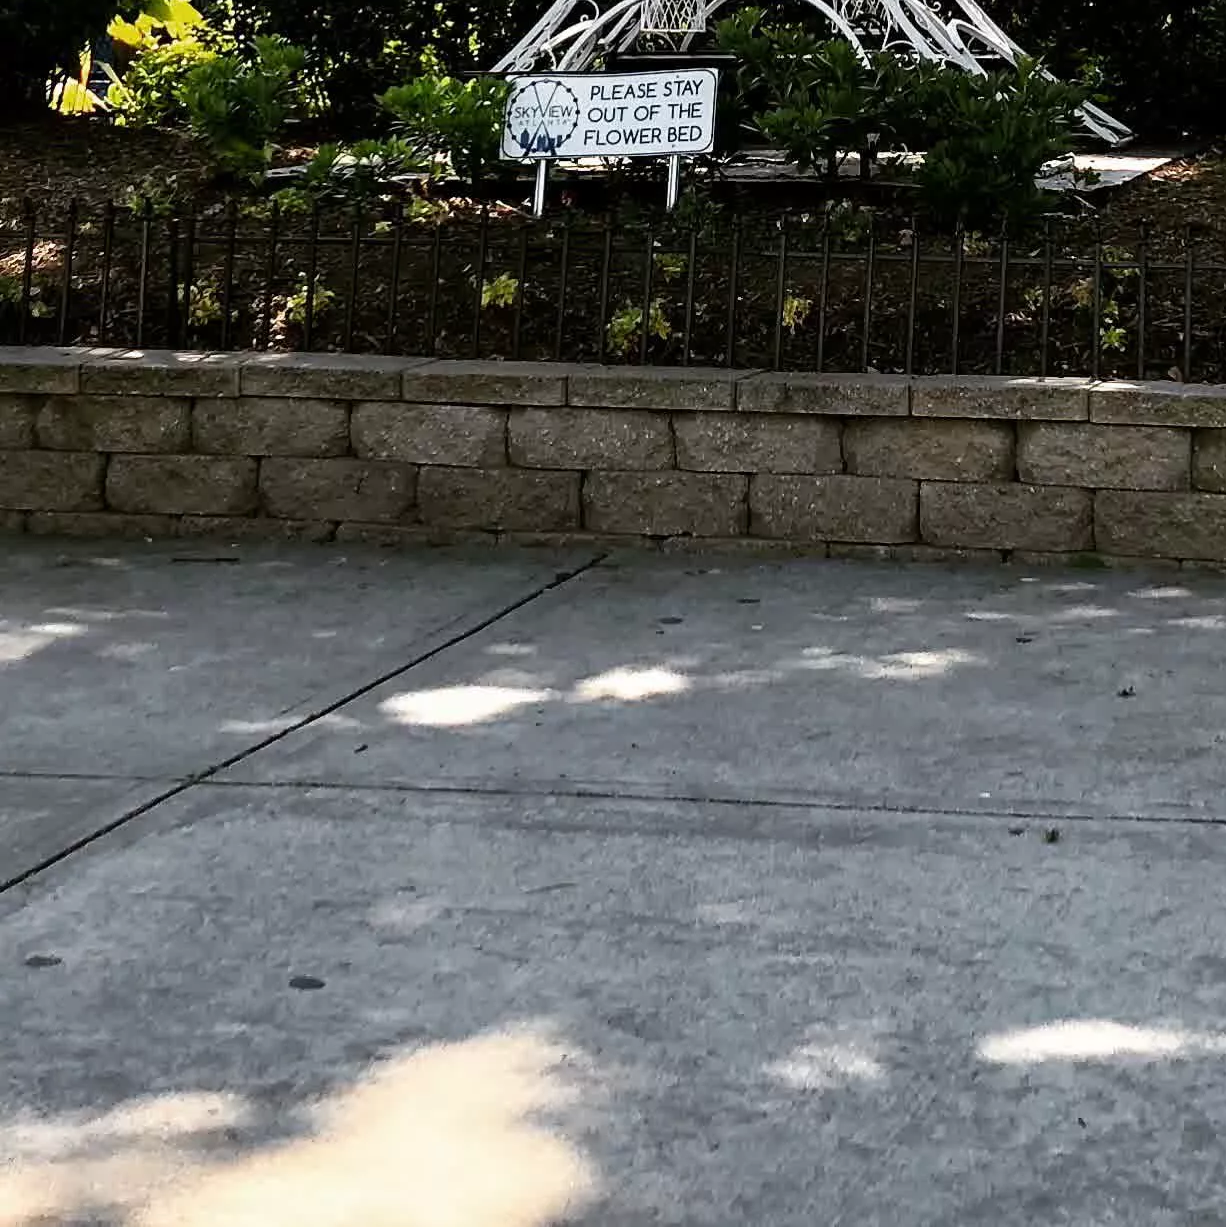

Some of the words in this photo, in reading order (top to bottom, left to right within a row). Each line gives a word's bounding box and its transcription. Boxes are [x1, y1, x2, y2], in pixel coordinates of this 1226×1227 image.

[590, 83, 657, 101] PLEASE
[663, 79, 704, 97] STAY
[513, 104, 574, 119] SKYVIEW
[587, 106, 628, 123] OUT
[633, 105, 661, 121] OF
[667, 102, 703, 119] THE
[584, 126, 662, 146] FLOWER
[667, 125, 702, 143] BED
